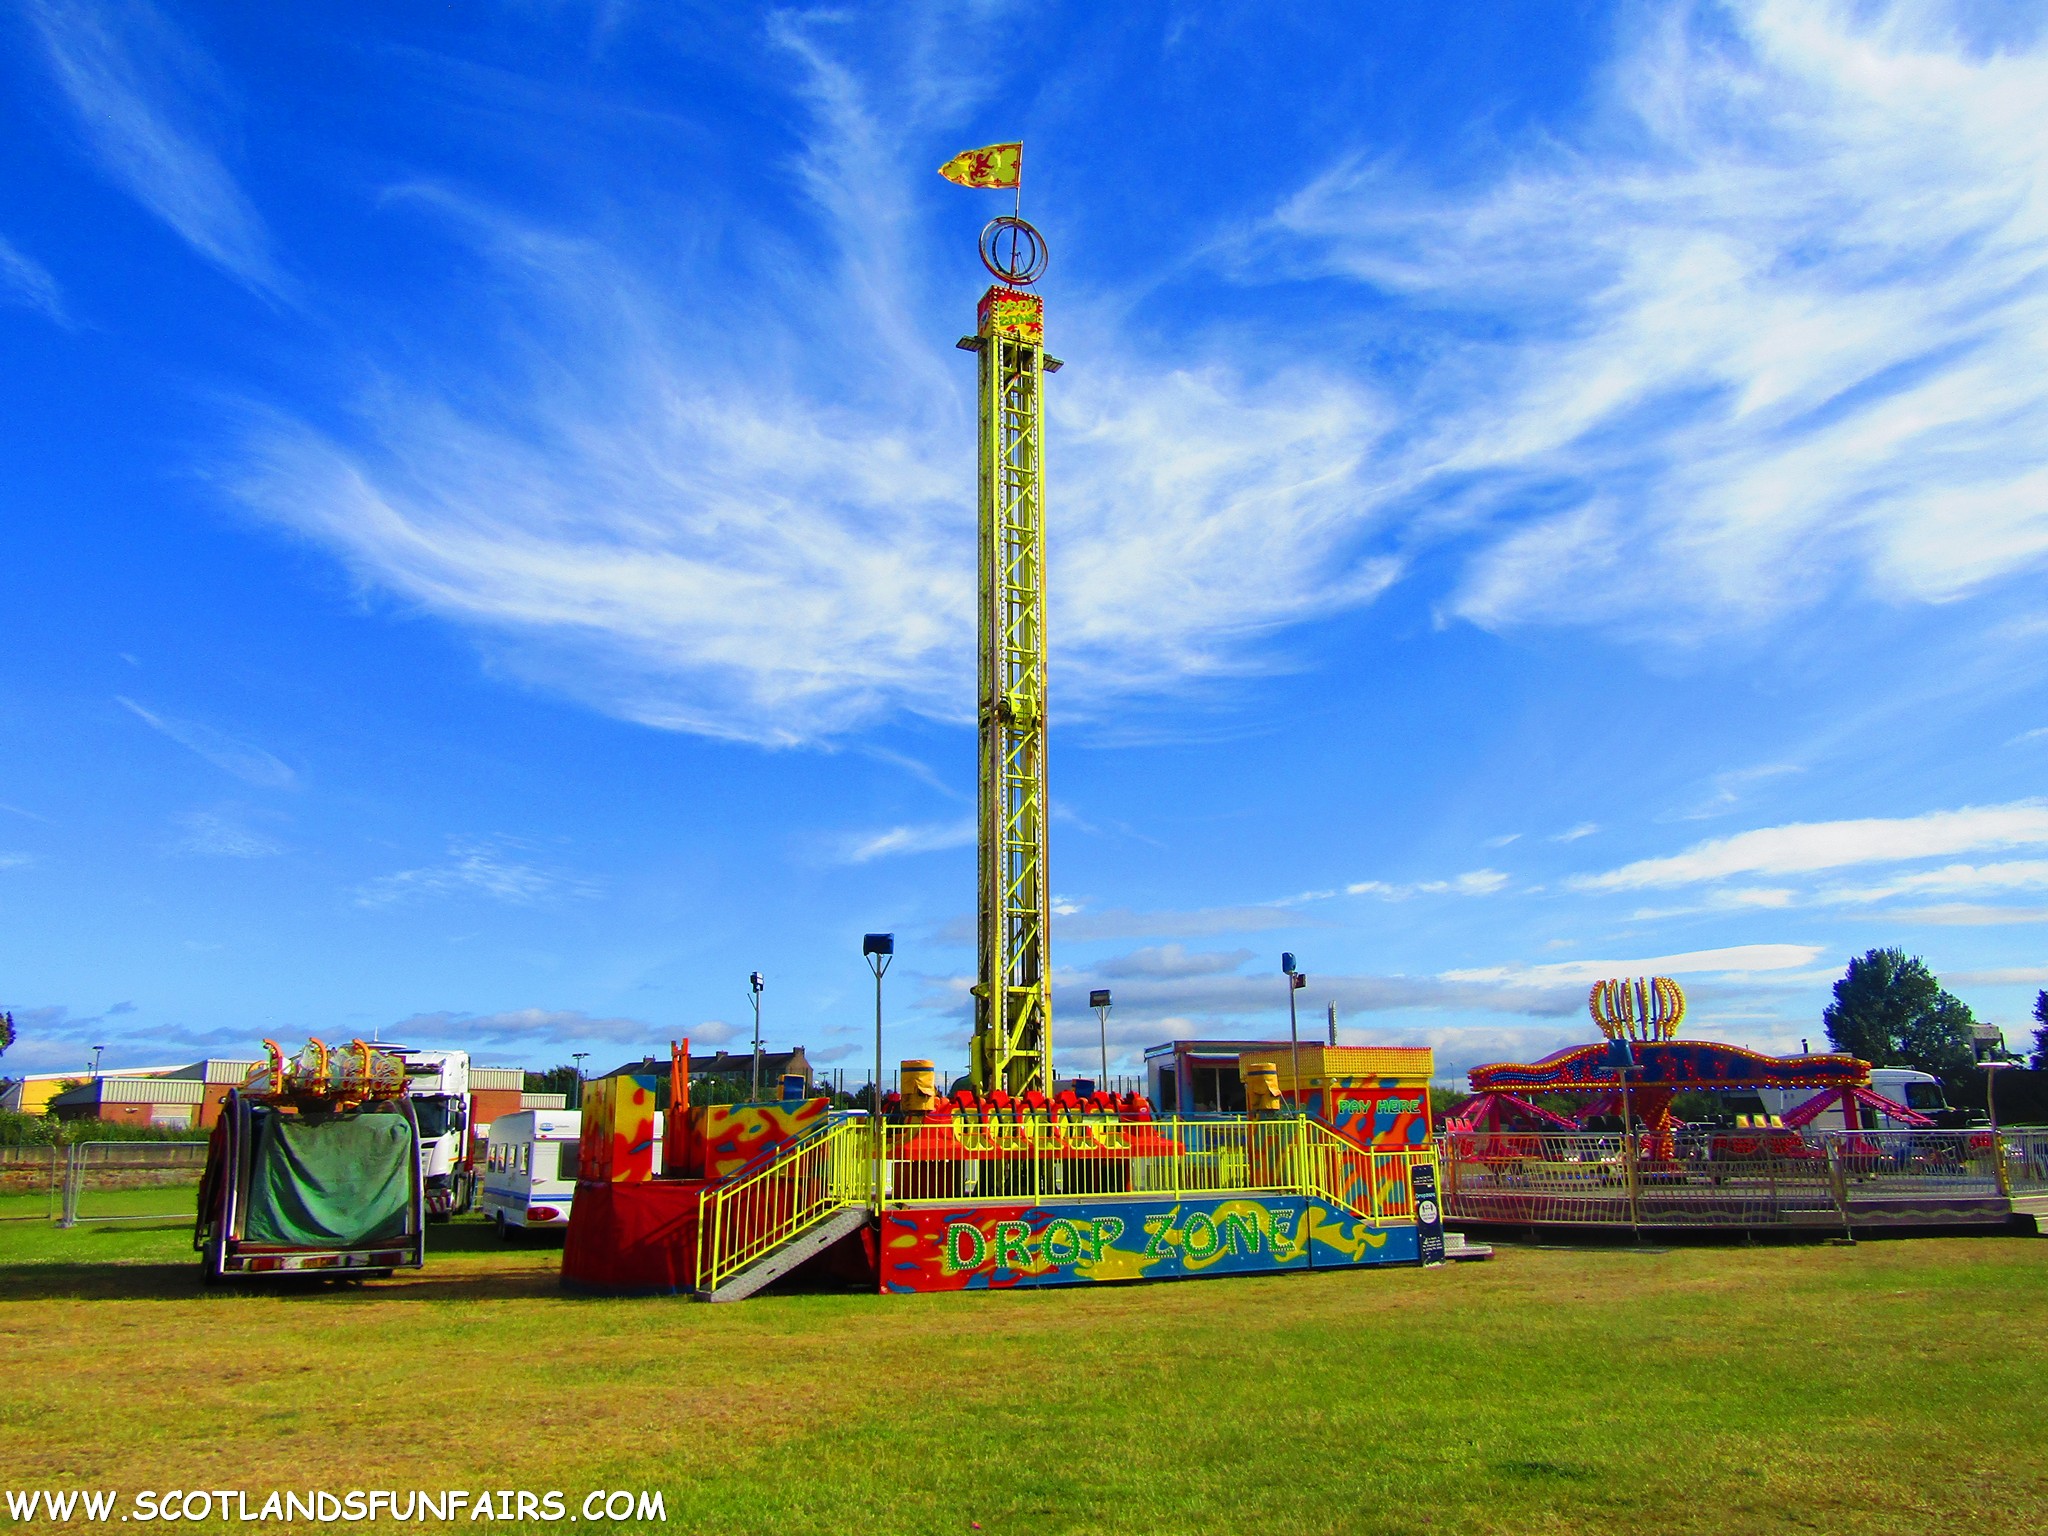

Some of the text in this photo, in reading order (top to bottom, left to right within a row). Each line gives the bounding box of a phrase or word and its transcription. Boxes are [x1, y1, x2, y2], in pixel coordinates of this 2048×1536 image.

[998, 313, 1037, 326] ZONE
[1338, 1099, 1421, 1114] PAY HERE
[946, 1208, 1298, 1272] DROP ZONE
